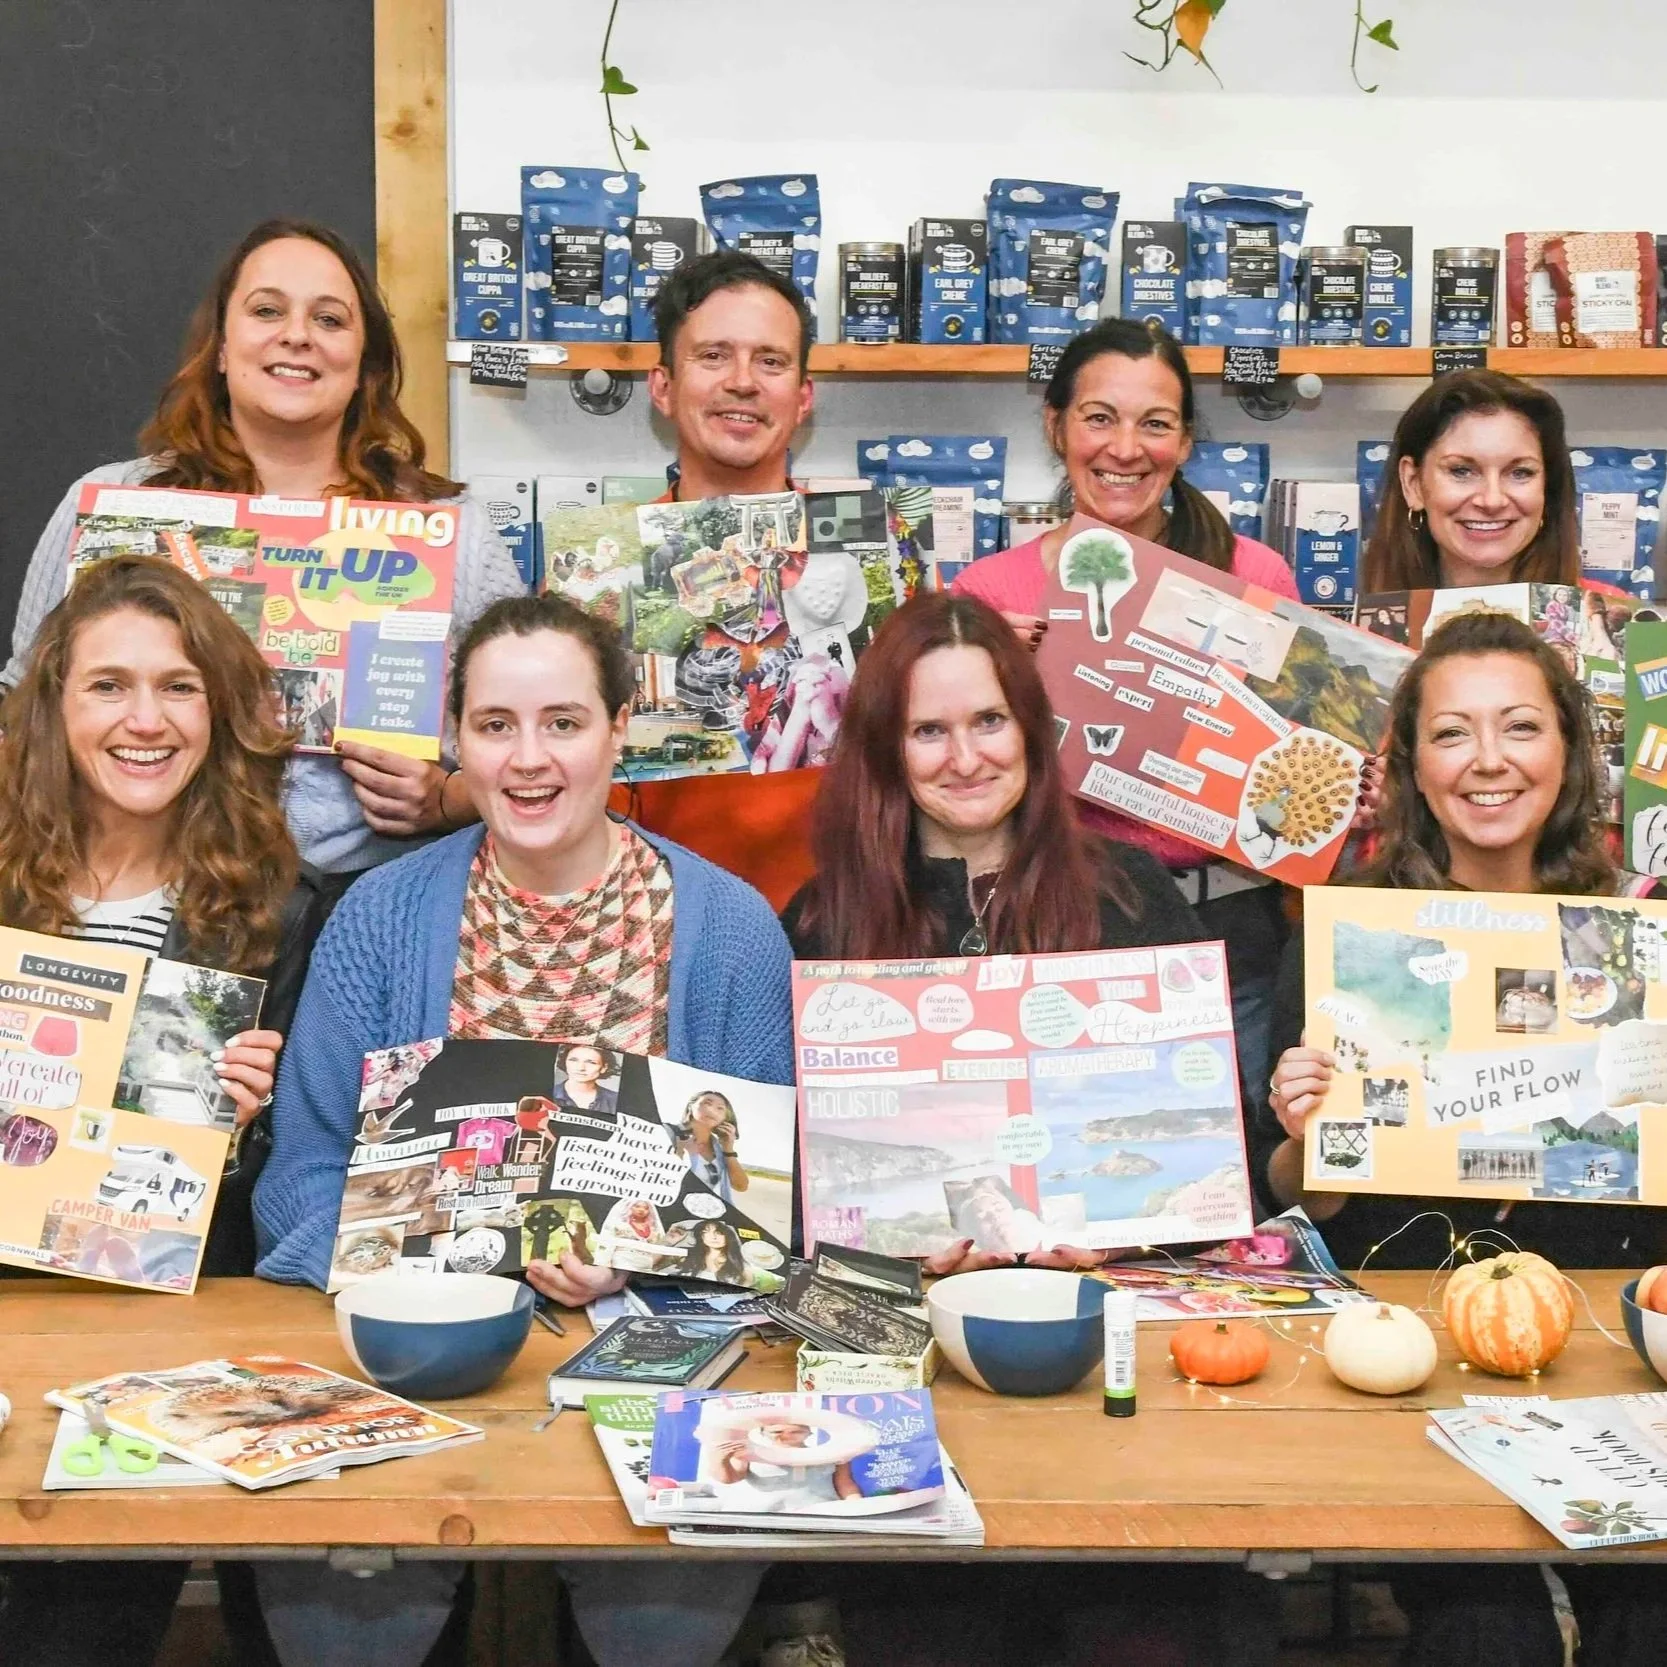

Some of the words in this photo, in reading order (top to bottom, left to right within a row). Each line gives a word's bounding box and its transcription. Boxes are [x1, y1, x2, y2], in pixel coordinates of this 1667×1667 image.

[1040, 238, 1056, 246] EARL
[1236, 230, 1270, 238] CHOCOLATE
[463, 273, 486, 284] GREAT
[488, 273, 517, 284] BRITISH
[850, 282, 883, 290] BREAKFAST
[884, 282, 898, 290] BREW
[935, 278, 954, 288] EARL
[954, 279, 974, 289] GREY
[1134, 279, 1175, 289] CHOCOLATE
[1323, 276, 1356, 285] CHOCOLATE
[1370, 283, 1394, 292] CREME
[478, 284, 502, 295] CUPPA
[942, 290, 967, 301] CREME
[1134, 291, 1174, 300] DIGESTIVES
[1582, 300, 1613, 308] STICKY
[332, 496, 455, 547] living
[262, 547, 324, 563] TURN
[1312, 542, 1336, 550] LEMON
[341, 548, 418, 584] UP
[300, 566, 338, 590] IT
[267, 632, 289, 647] be
[296, 634, 337, 652] bold
[288, 649, 312, 664] be
[371, 654, 377, 664] I
[380, 656, 424, 668] create
[1130, 638, 1173, 659] personal
[1174, 654, 1205, 672] values
[366, 669, 390, 683] joy
[394, 670, 426, 683] with
[1078, 668, 1110, 688] Listening
[376, 688, 415, 700] every
[1152, 670, 1216, 708] Empathy
[1118, 690, 1152, 708] expert
[1223, 676, 1241, 695] your
[1242, 692, 1258, 708] own
[1258, 704, 1289, 734] captain
[379, 702, 410, 715] step
[371, 716, 377, 726] I
[380, 718, 415, 728] take.
[1186, 711, 1203, 724] New
[1205, 718, 1232, 736] Energy
[1089, 780, 1112, 798] like
[1114, 794, 1122, 803] a
[1125, 796, 1146, 815] ray
[1148, 806, 1163, 820] of
[1122, 780, 1180, 815] colourful
[1181, 799, 1218, 826] house
[1220, 820, 1231, 832] is
[1416, 899, 1547, 932] stillness
[26, 960, 120, 986] LONGEVITY
[804, 966, 814, 976] A
[815, 964, 842, 976] path
[902, 963, 924, 974] and
[816, 985, 859, 1016] Let
[864, 998, 889, 1016] go
[802, 1019, 833, 1034] and
[838, 1023, 864, 1041] go
[872, 1011, 911, 1029] slow
[928, 1016, 948, 1024] with
[1093, 1006, 1227, 1044] Happiness
[803, 1048, 896, 1068] Balance
[1038, 1051, 1152, 1074] AROMATHERAPY
[8, 1061, 79, 1086] create
[946, 1060, 1025, 1078] EXERCISE
[1476, 1058, 1534, 1088] FIND
[24, 1086, 48, 1104] of
[808, 1090, 900, 1118] HOLISTIC
[1433, 1091, 1501, 1122] YOUR
[1514, 1069, 1582, 1102] FLOW
[478, 1105, 510, 1116] WORK
[551, 1112, 621, 1133] Transform
[620, 1116, 654, 1134] You
[8, 1115, 52, 1164] Joy
[616, 1132, 662, 1153] have
[562, 1139, 615, 1160] listen
[620, 1150, 638, 1165] to
[639, 1158, 688, 1174] your
[556, 1157, 638, 1182] feelings
[640, 1171, 676, 1188] like
[560, 1176, 572, 1186] a
[474, 1180, 512, 1195] Dream
[1210, 1192, 1226, 1200] can
[438, 1198, 456, 1210] Rest
[1192, 1202, 1237, 1212] overcome
[51, 1200, 114, 1222] CAMPER
[120, 1212, 151, 1230] VAN
[1196, 1212, 1238, 1224] anything
[812, 1220, 856, 1230] ROMAN
[817, 1230, 852, 1240] BATHS
[618, 1398, 650, 1406] the
[318, 1423, 350, 1436] UP
[359, 1416, 416, 1430] FOR
[256, 1424, 439, 1468] Autumn
[1638, 1532, 1659, 1542] BOOK
